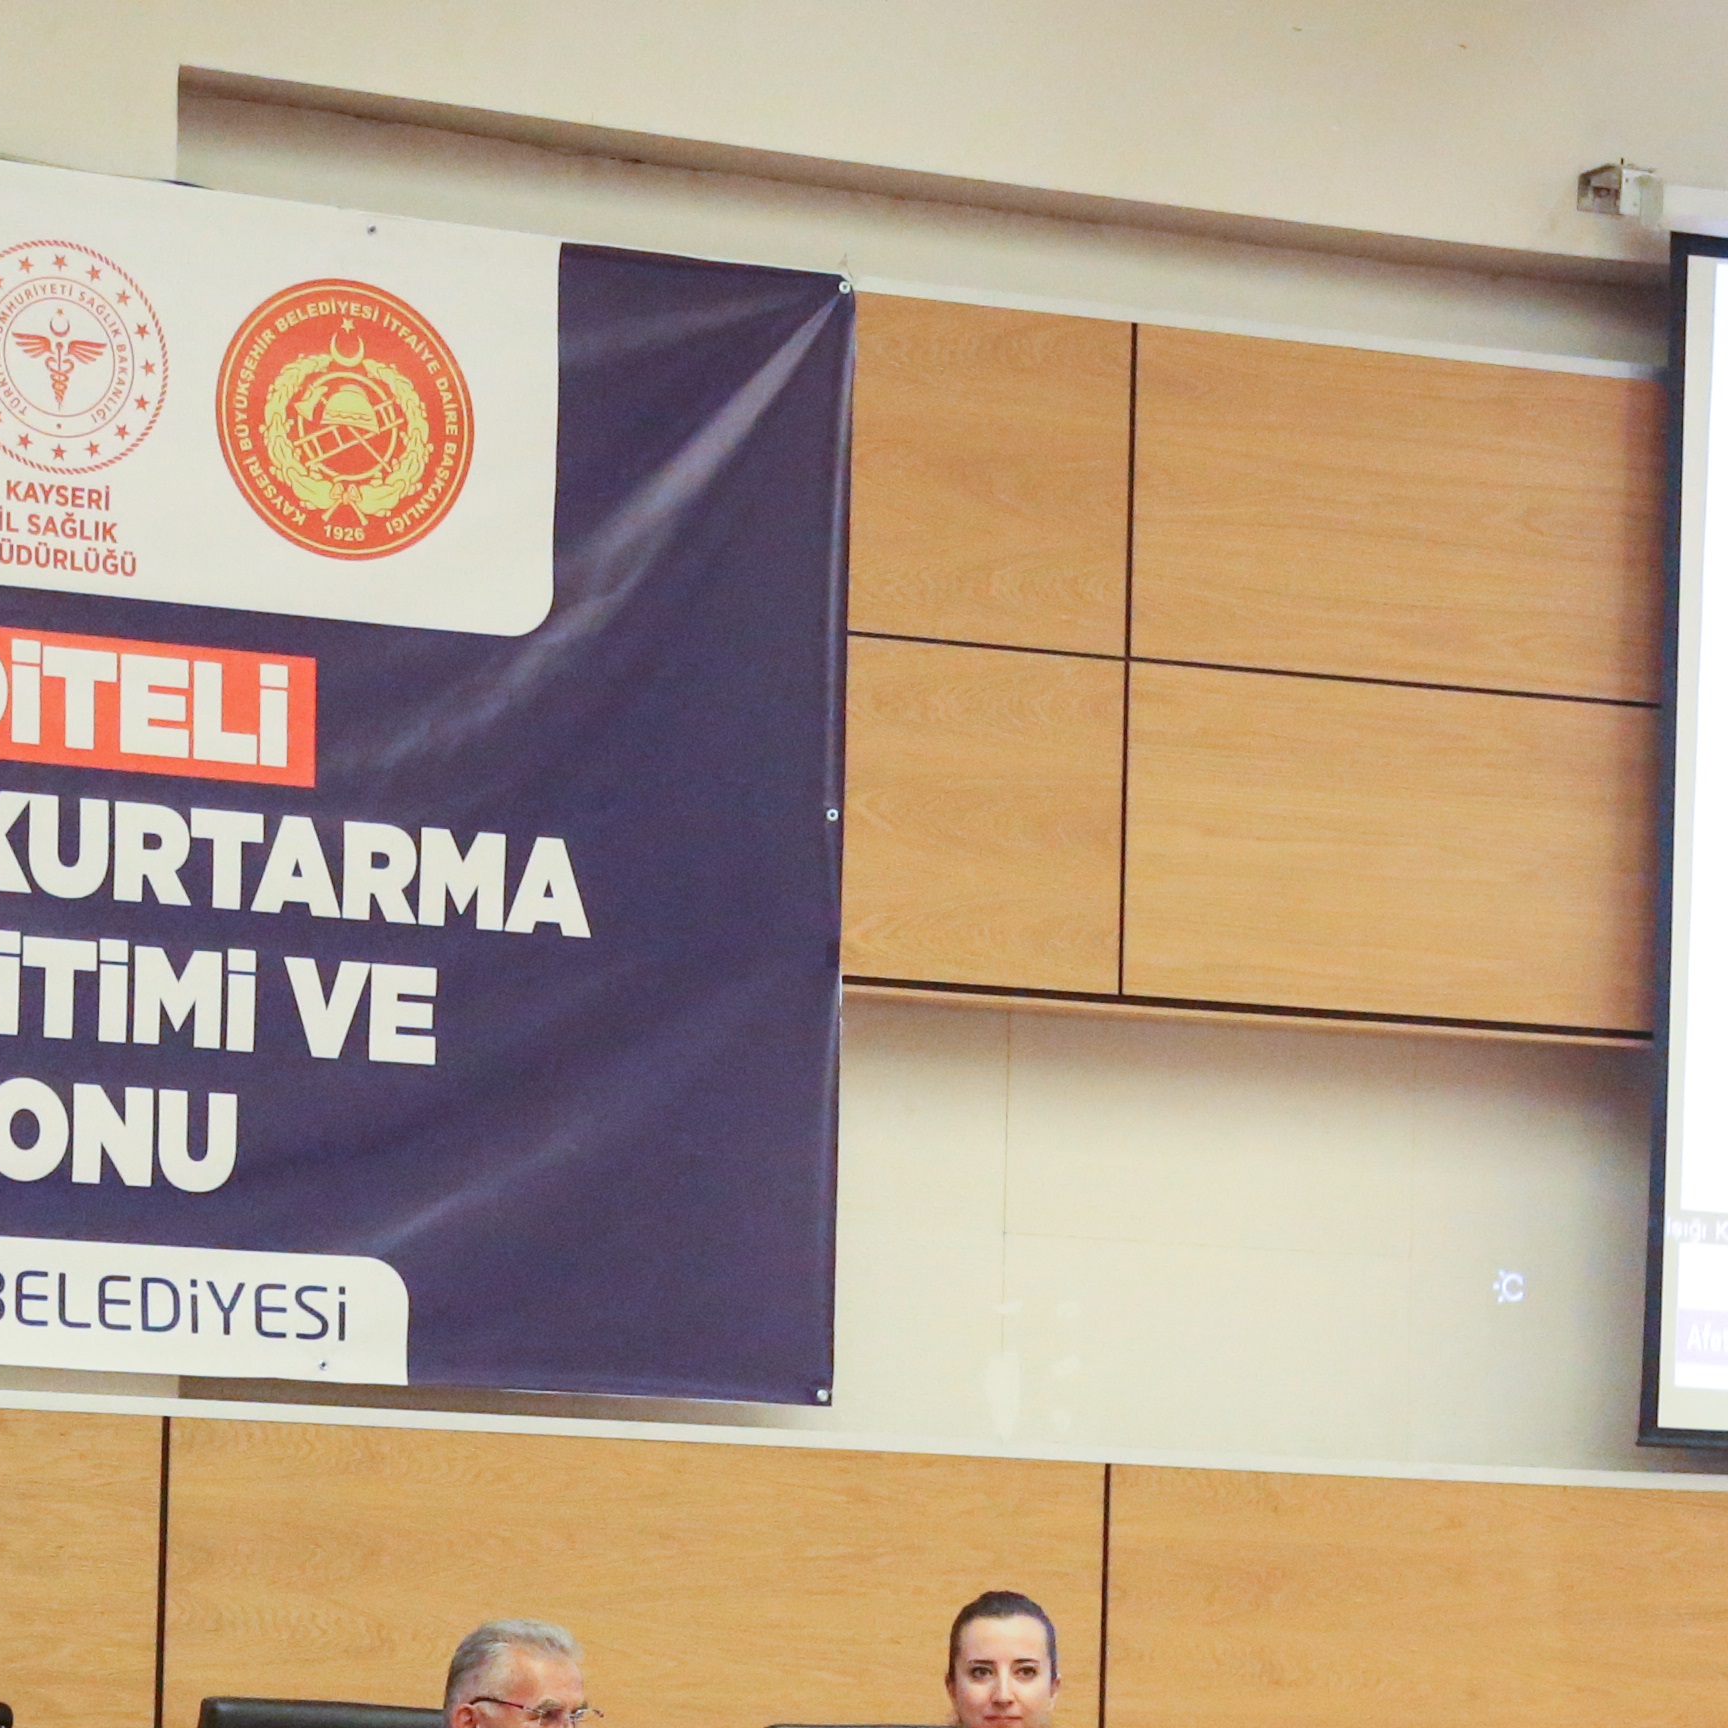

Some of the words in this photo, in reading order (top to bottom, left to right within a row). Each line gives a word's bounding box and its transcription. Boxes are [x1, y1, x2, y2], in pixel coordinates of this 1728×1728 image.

[78, 291, 122, 338] SAĞLIK
[275, 298, 380, 333] BELEDİYESİ
[383, 312, 441, 375] İTFAİYE
[234, 329, 276, 451] BÜYÜKŞEHİR
[436, 377, 459, 437] DAİRE
[6, 480, 110, 511] KAYSERİ
[385, 442, 459, 536] BAŞKANLIĞI
[27, 512, 117, 543] SAĞLIK
[323, 525, 365, 542] 1926
[283, 956, 438, 1065] VE
